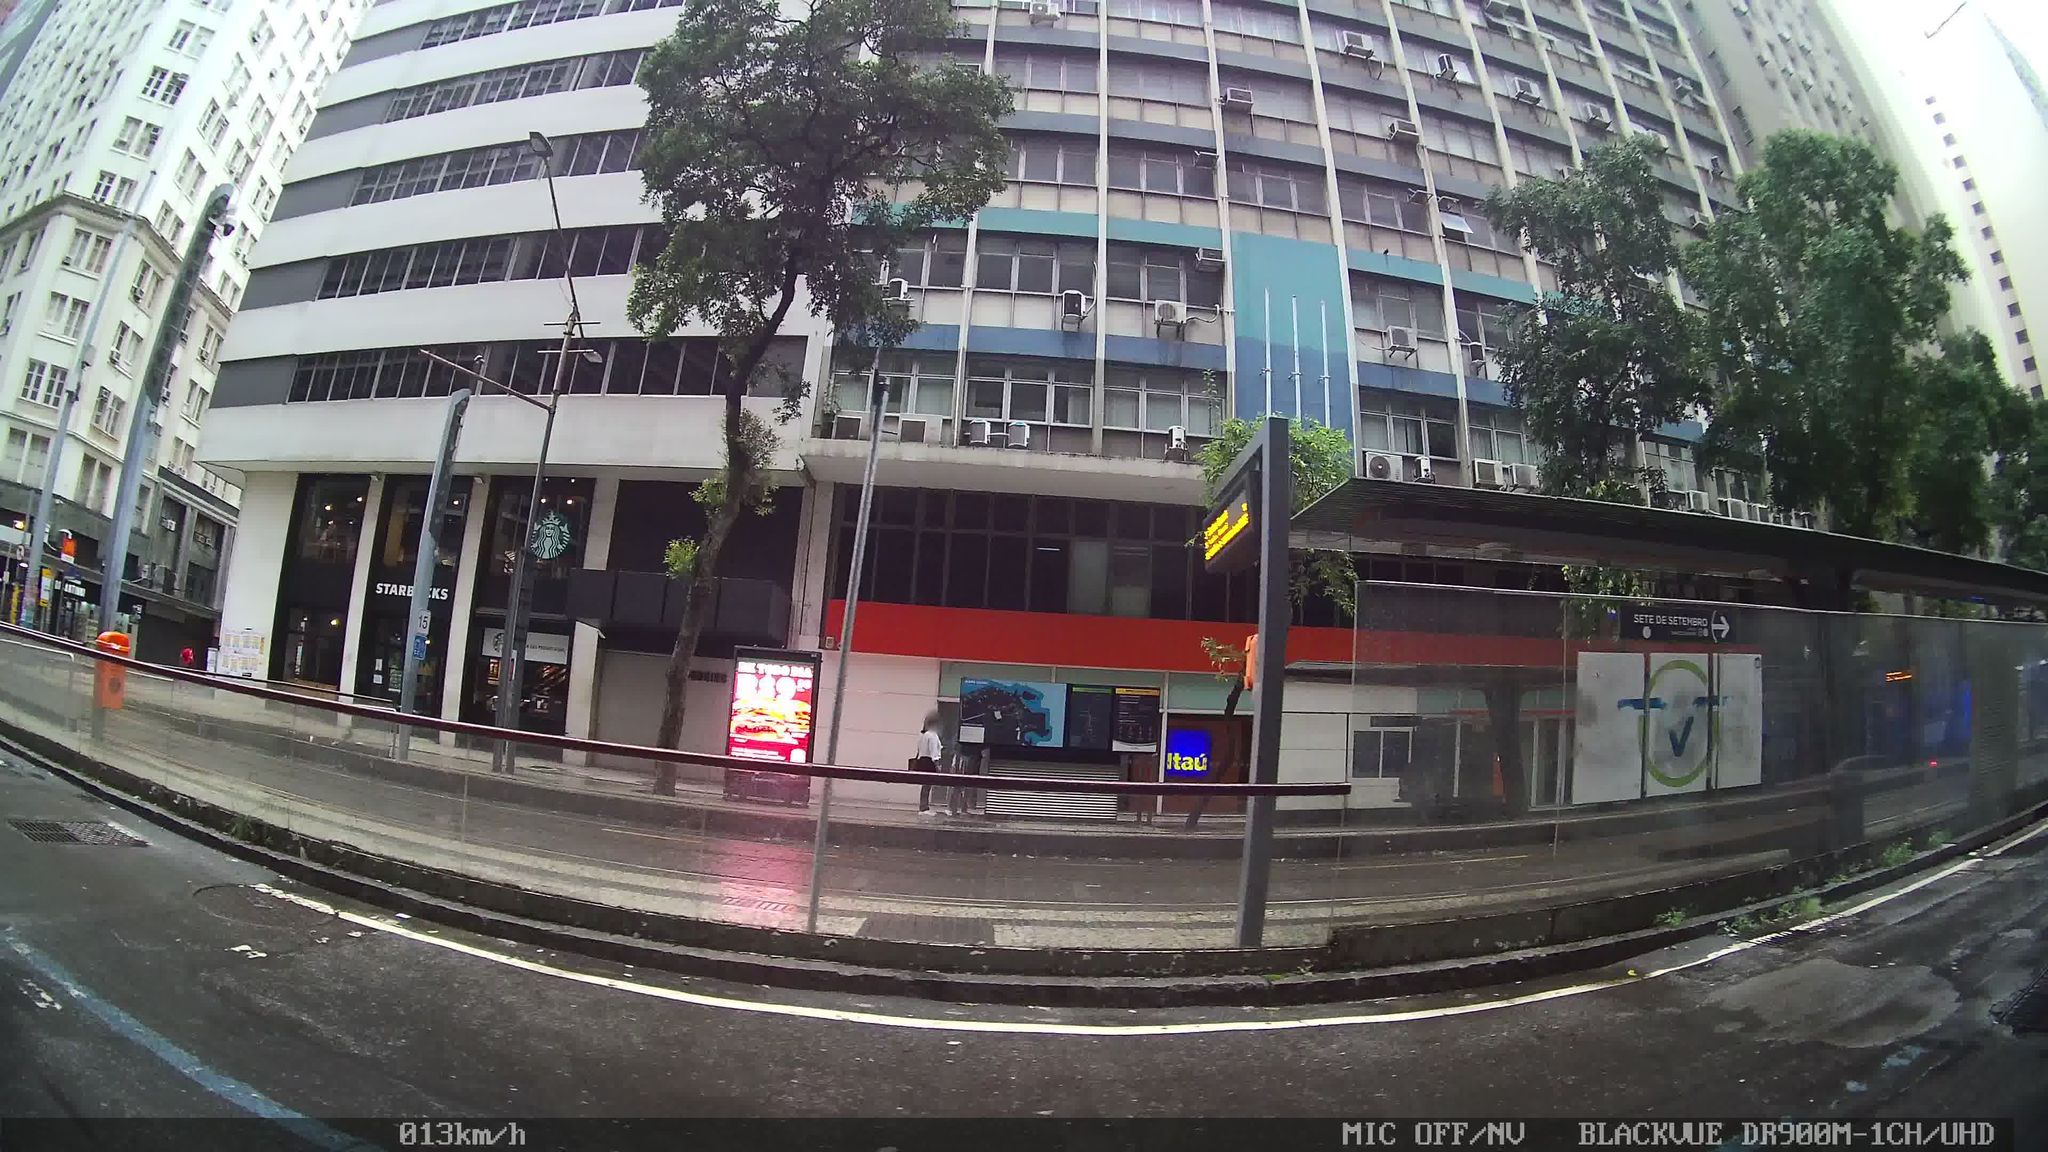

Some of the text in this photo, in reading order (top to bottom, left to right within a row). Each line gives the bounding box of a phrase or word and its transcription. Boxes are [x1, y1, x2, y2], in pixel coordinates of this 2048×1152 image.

[376, 583, 448, 600] STARBKS
[1633, 614, 1709, 627] SETE DE SETEMBRO
[1167, 753, 1207, 771] Itaú
